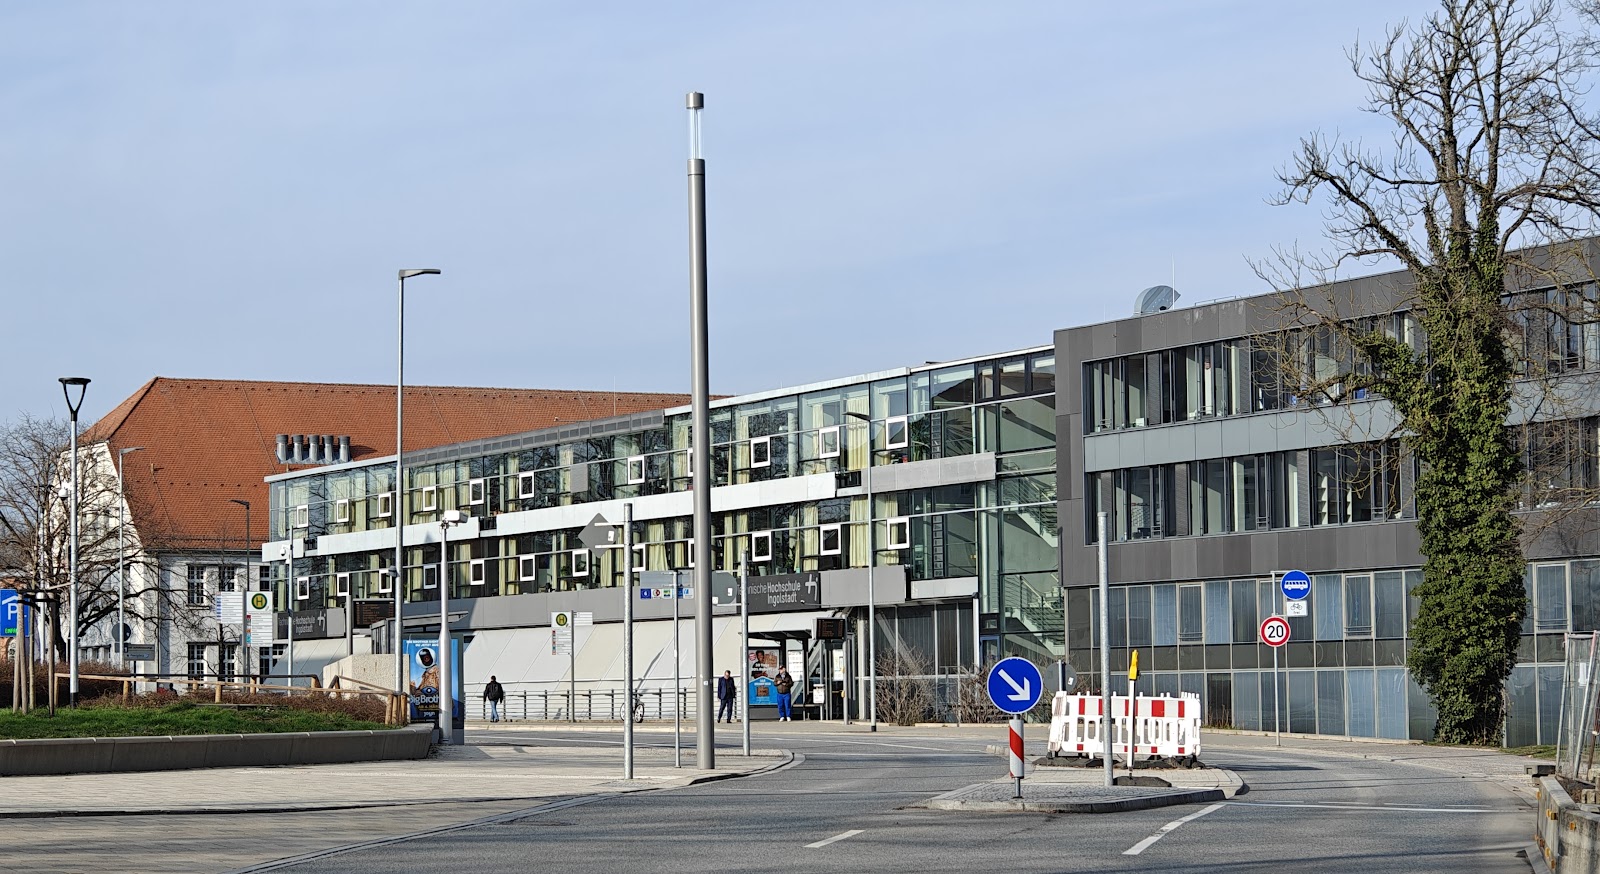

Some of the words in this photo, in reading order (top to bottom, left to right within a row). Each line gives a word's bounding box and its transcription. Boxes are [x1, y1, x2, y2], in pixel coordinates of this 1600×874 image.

[737, 582, 767, 595] Tenische
[767, 580, 800, 593] Hochschule
[256, 597, 263, 606] H
[767, 592, 797, 607] Ingolstadt
[1267, 625, 1284, 638] 20
[421, 694, 440, 704] Broth
